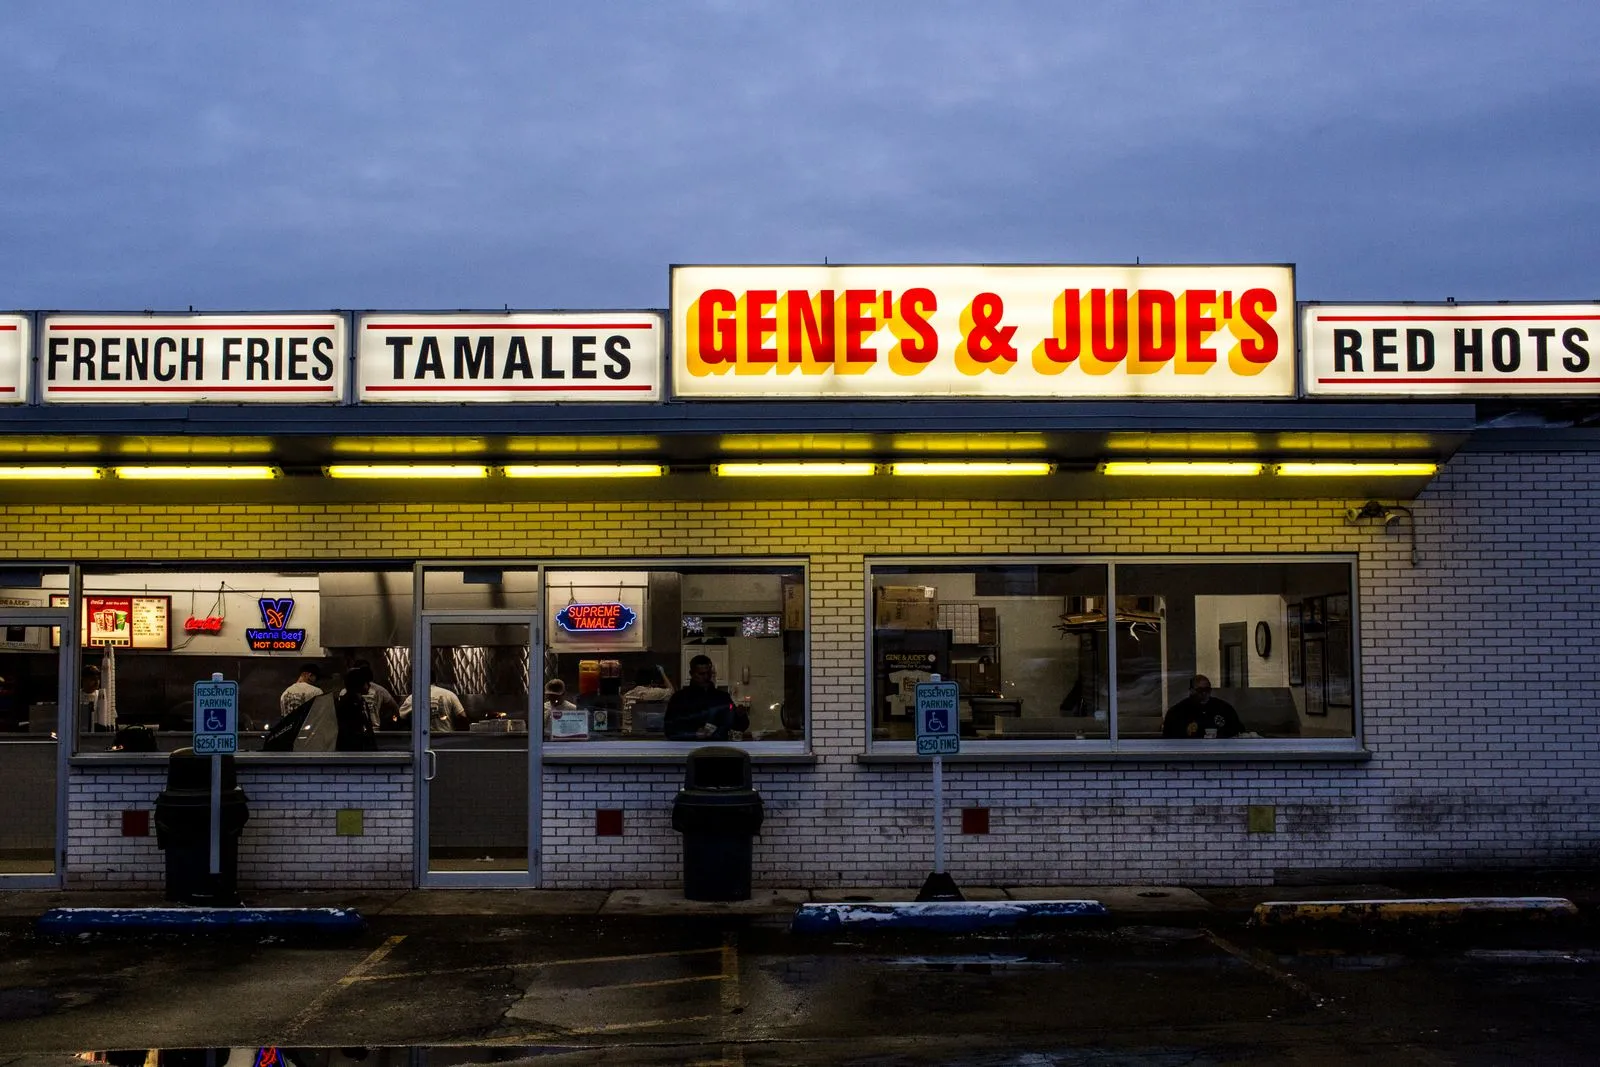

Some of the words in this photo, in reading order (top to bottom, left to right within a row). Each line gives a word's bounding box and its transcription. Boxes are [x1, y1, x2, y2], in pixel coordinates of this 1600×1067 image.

[698, 287, 938, 364] GENE'S
[967, 292, 1018, 363] &
[1044, 287, 1279, 364] JUDE'S
[1333, 328, 1435, 372] RED
[1453, 327, 1590, 373] HOTS
[48, 336, 204, 381] FRENCH
[221, 336, 334, 381] FRIES
[385, 335, 631, 380] TAMALES
[568, 605, 621, 618] SUPREME
[574, 617, 616, 629] TAMALE
[248, 630, 279, 639] Vienna
[282, 630, 303, 641] Beef
[253, 641, 271, 649] HOT
[273, 641, 296, 649] DOGS
[197, 687, 235, 697] RESERVED
[918, 688, 956, 698] RESERVED
[200, 699, 232, 708] PARKING
[920, 700, 954, 709] PARKING
[196, 738, 216, 749] $250
[218, 737, 234, 749] FINE
[919, 739, 938, 750] $250
[940, 738, 957, 749] FINE
